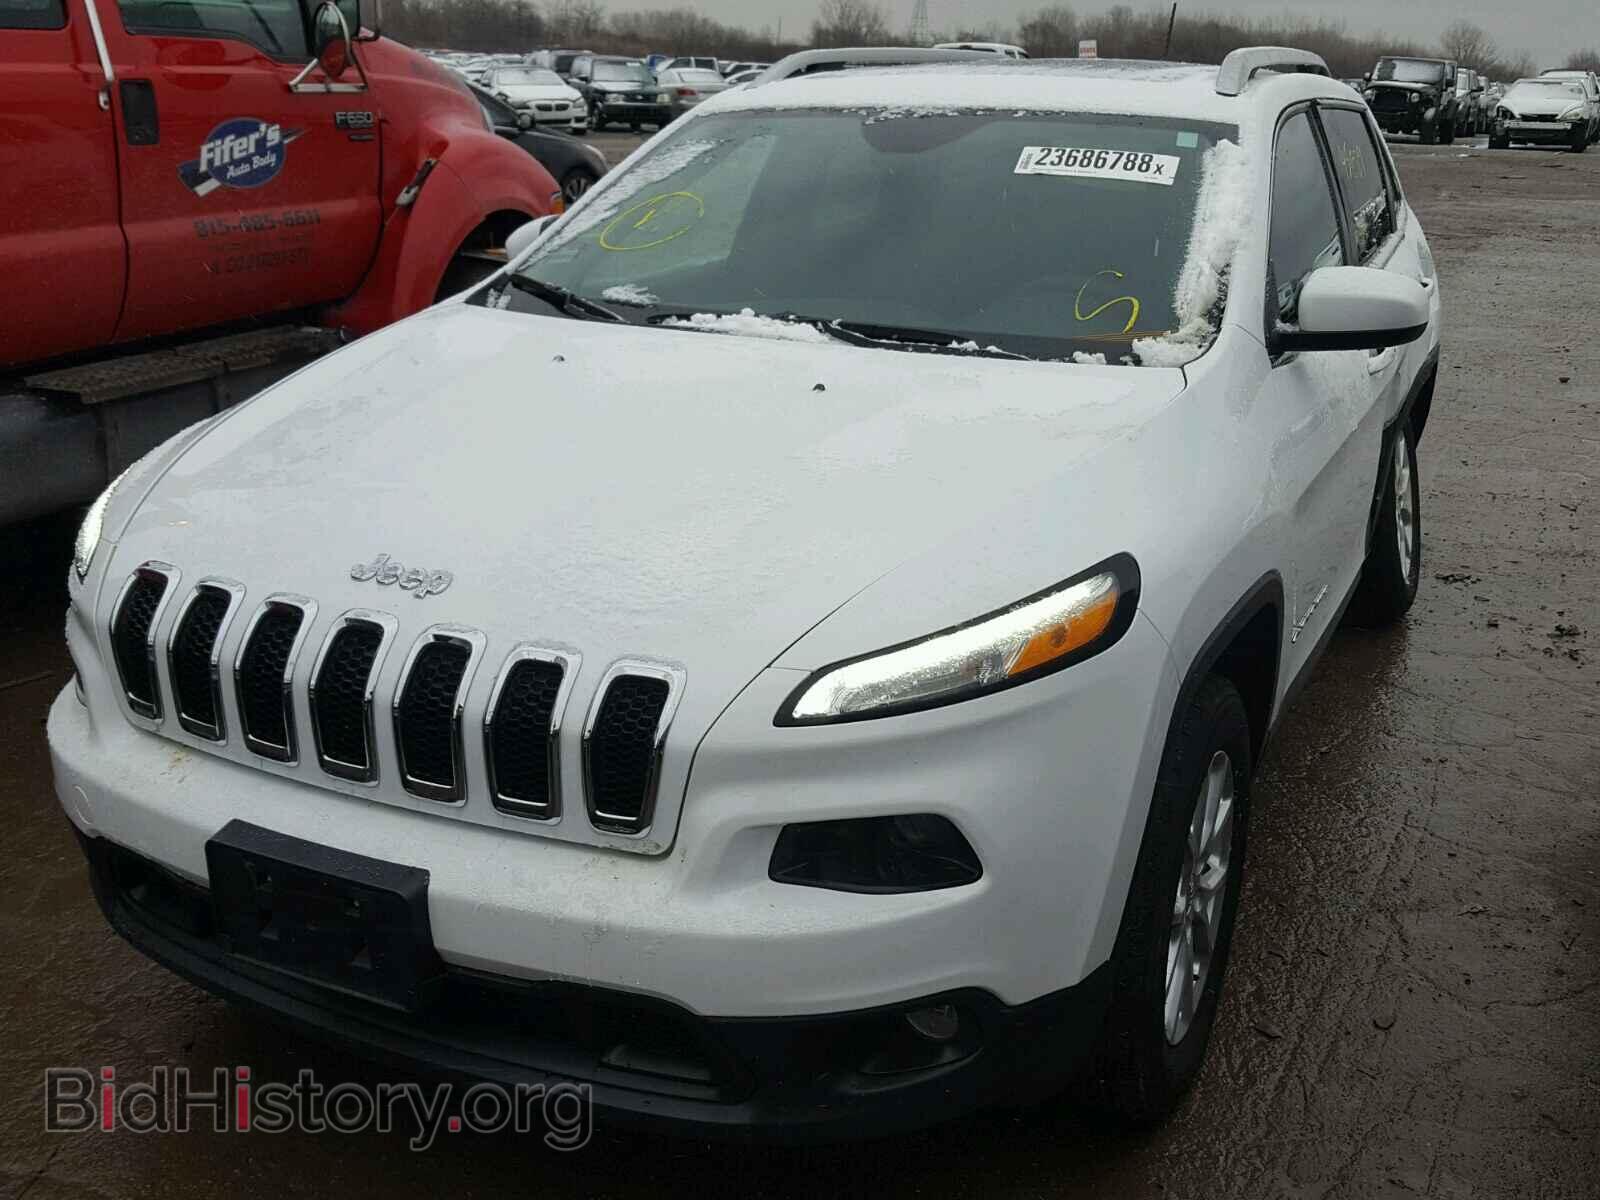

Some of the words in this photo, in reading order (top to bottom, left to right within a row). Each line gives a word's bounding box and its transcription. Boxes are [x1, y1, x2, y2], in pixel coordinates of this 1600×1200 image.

[199, 122, 281, 173] Fifer's
[226, 163, 251, 179] Auto
[252, 151, 277, 168] Body
[350, 552, 453, 600] Jeep
